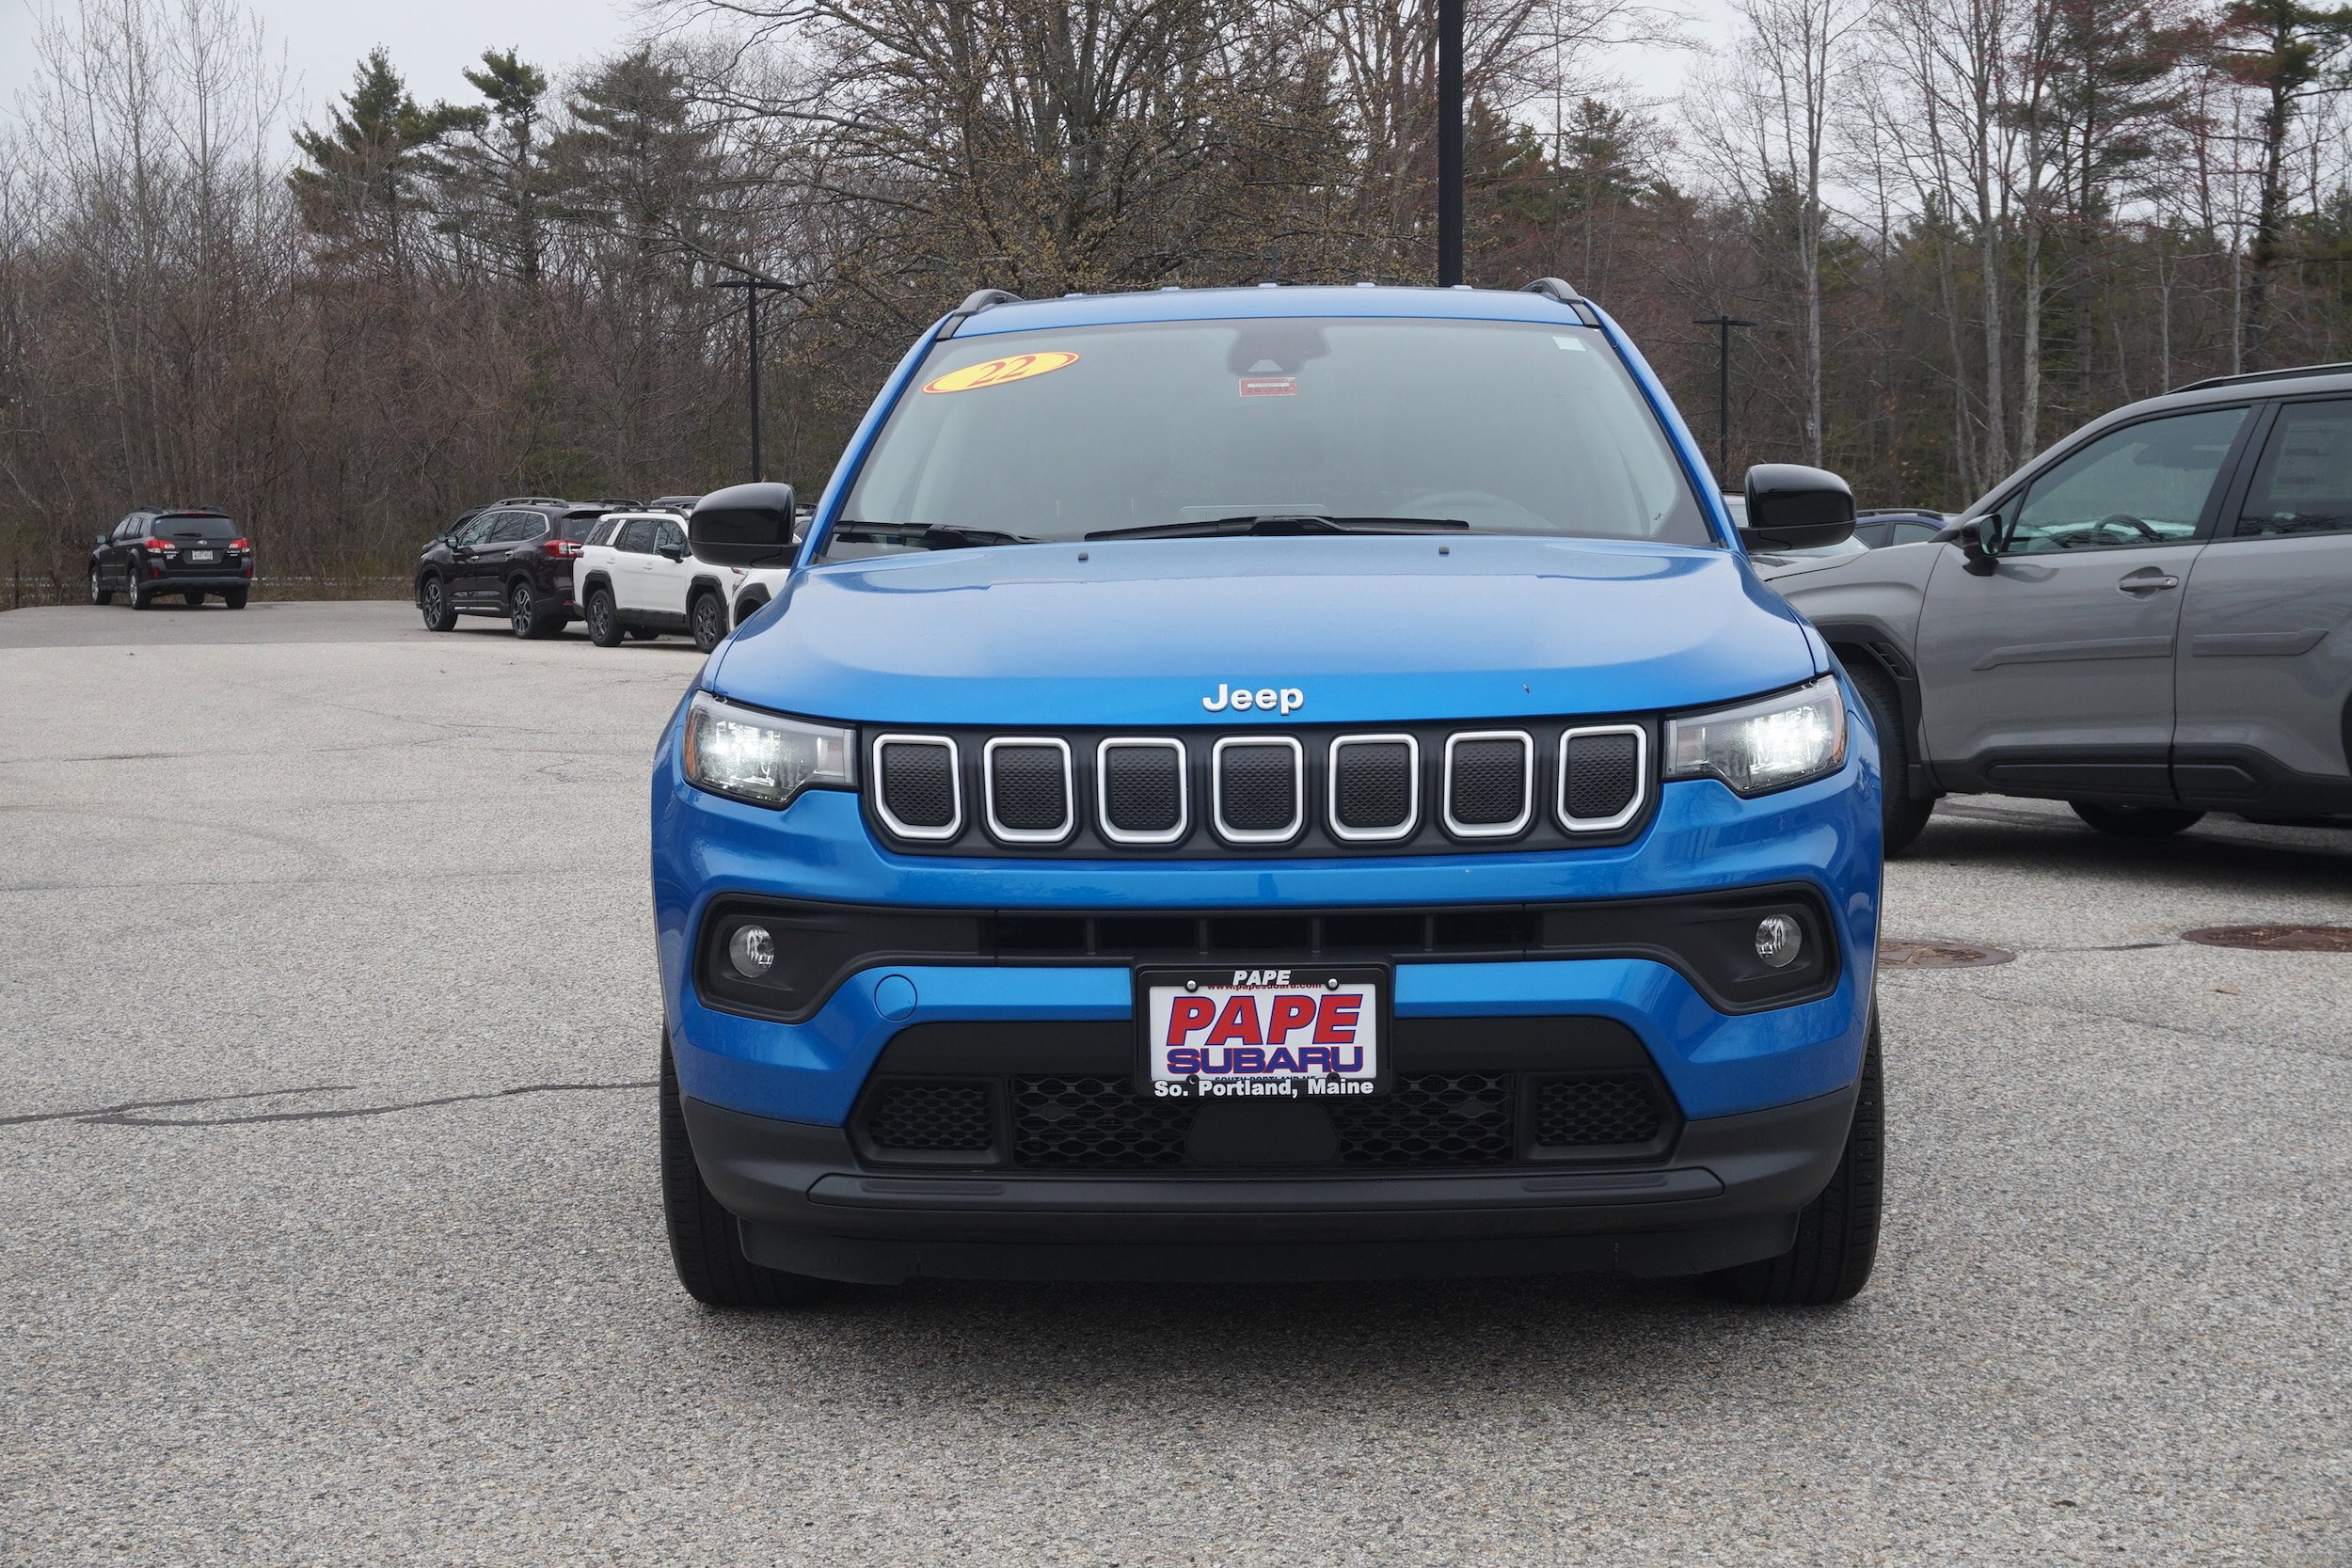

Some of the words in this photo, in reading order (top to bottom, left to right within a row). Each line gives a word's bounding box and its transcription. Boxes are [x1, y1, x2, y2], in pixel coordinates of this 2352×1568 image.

[966, 355, 1037, 388] 22
[1202, 684, 1304, 716] Jeep
[1232, 970, 1291, 986] PAPE
[1166, 994, 1363, 1046] PAPE
[1167, 1046, 1364, 1074] SUBARU
[1154, 1080, 1188, 1098] So.
[1199, 1079, 1298, 1099] Portland,
[1308, 1079, 1374, 1094] Maine
